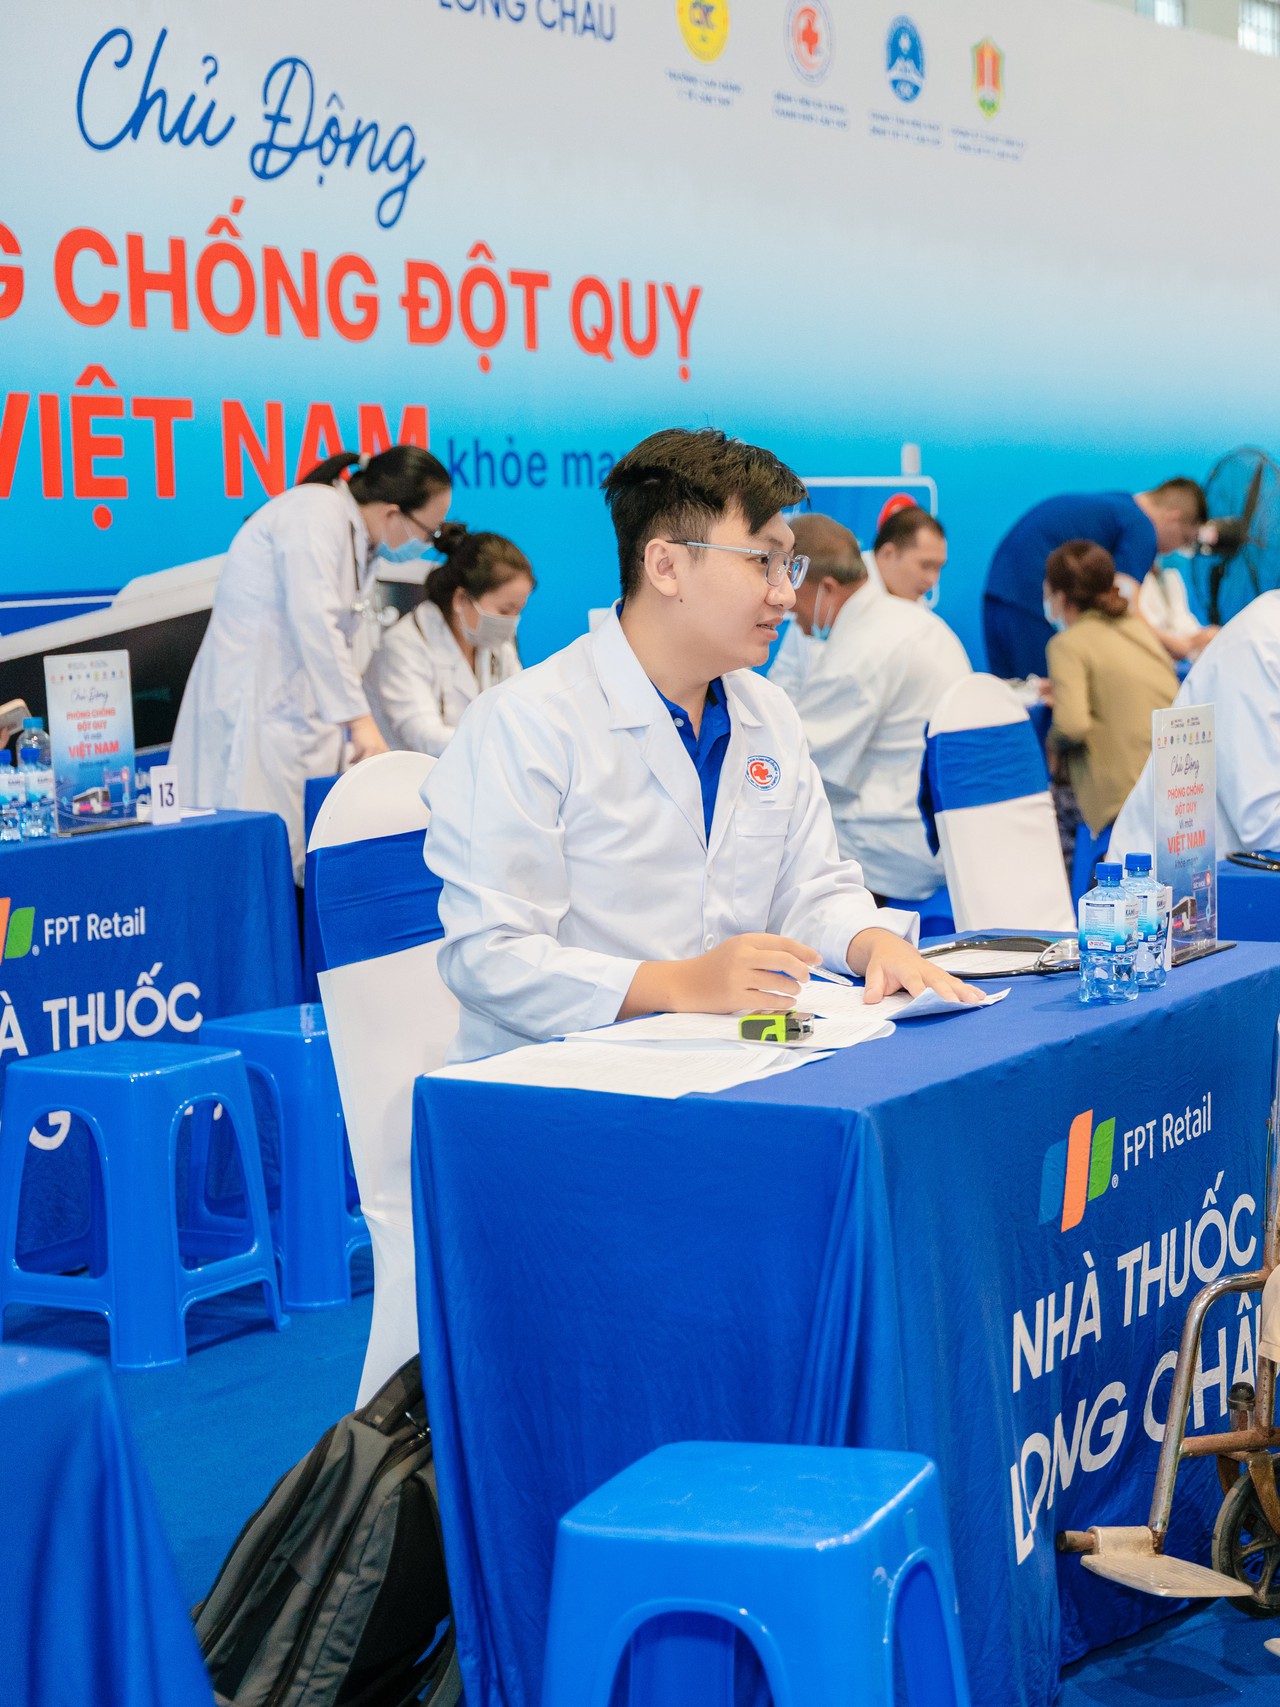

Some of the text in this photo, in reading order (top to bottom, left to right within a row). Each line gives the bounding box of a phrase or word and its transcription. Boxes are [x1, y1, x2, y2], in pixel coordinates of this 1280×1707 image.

[76, 27, 427, 230] Chủ Động
[53, 196, 381, 344] CHỐNG
[399, 240, 551, 375] ĐỘT
[570, 275, 703, 382] QUỴ
[221, 398, 432, 499] NAM
[448, 433, 548, 488] khỏe
[94, 739, 119, 755] NAM
[158, 781, 175, 808] 13
[1167, 829, 1206, 857] VIỆT NAM
[44, 906, 146, 946] FPT Retail
[42, 961, 204, 1052] THUỐC
[1124, 1092, 1212, 1171] FPT Retail
[1012, 1170, 1258, 1394] NHÀ THUỐC
[1010, 1380, 1129, 1566] LONG
